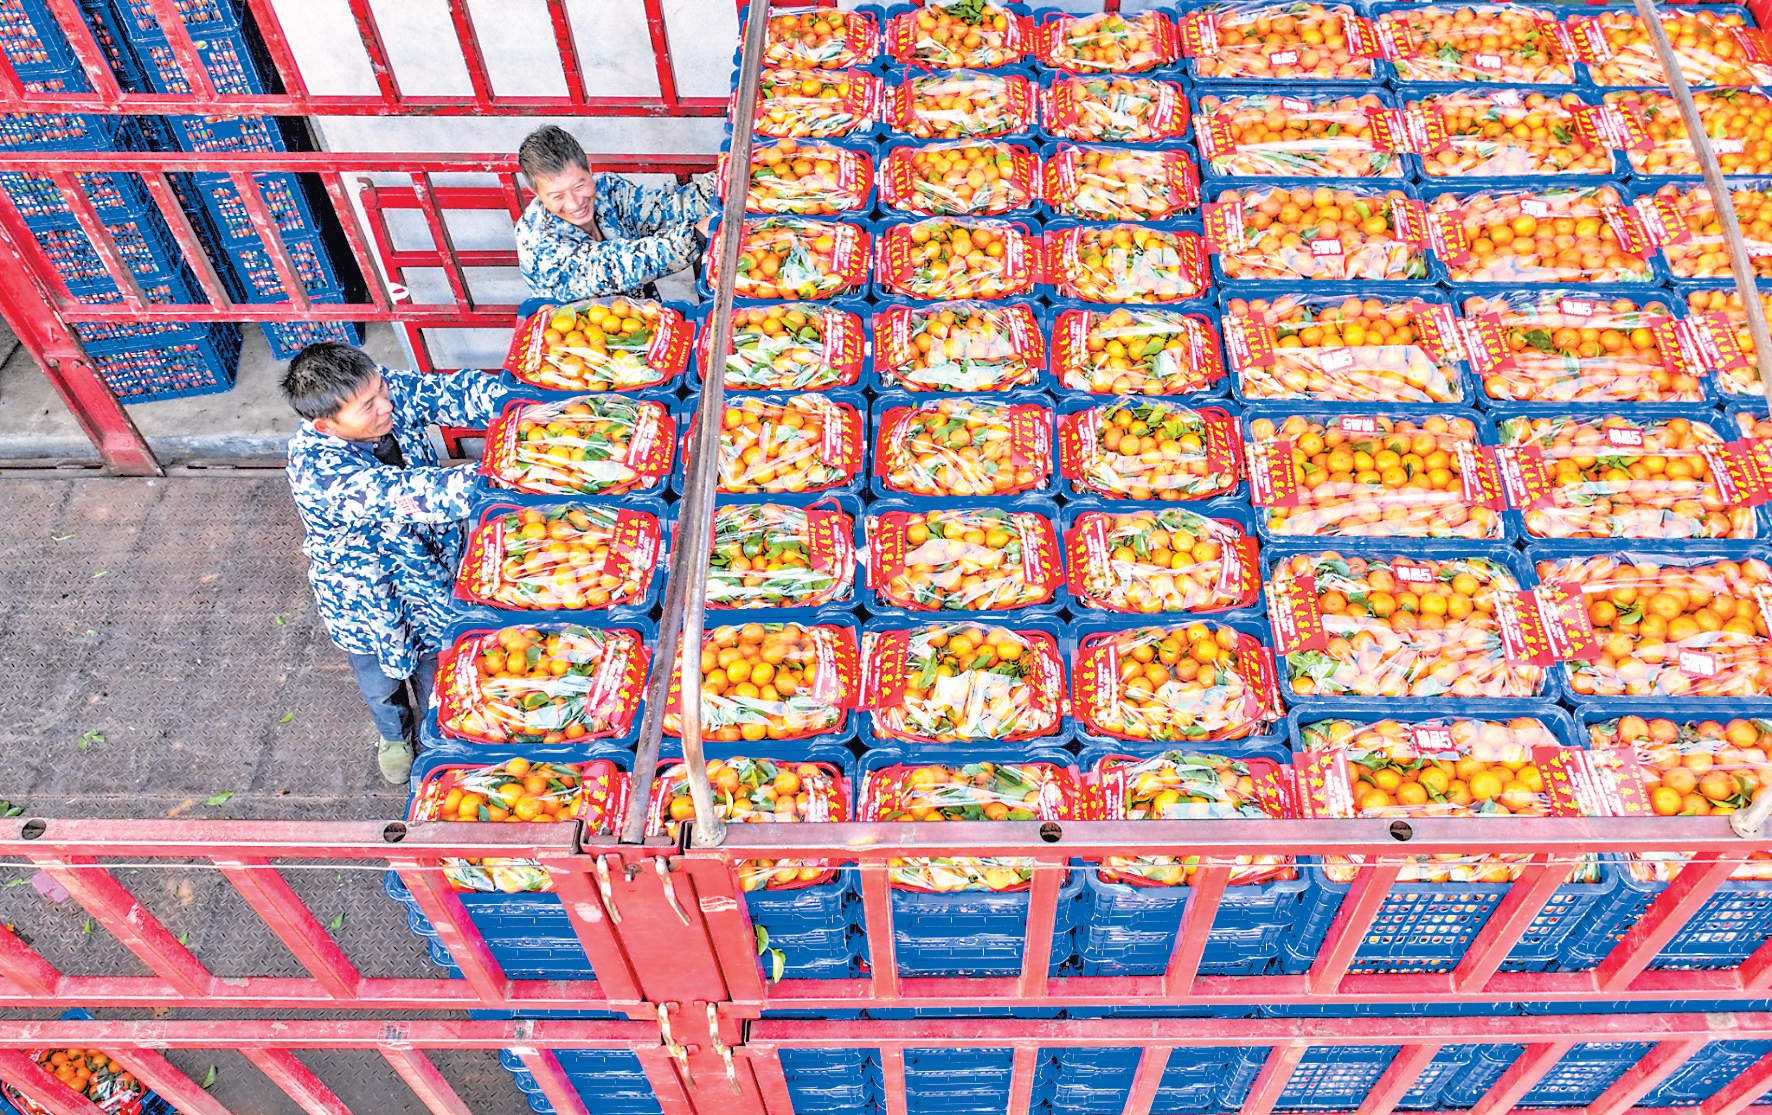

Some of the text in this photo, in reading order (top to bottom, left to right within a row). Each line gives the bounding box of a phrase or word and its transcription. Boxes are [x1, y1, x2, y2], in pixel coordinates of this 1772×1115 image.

[1562, 299, 1592, 316] 精品5
[1342, 417, 1375, 432] 精品5
[1608, 429, 1642, 445] 精品5
[1397, 566, 1432, 582] 精品5
[1416, 729, 1453, 750] 精品5
